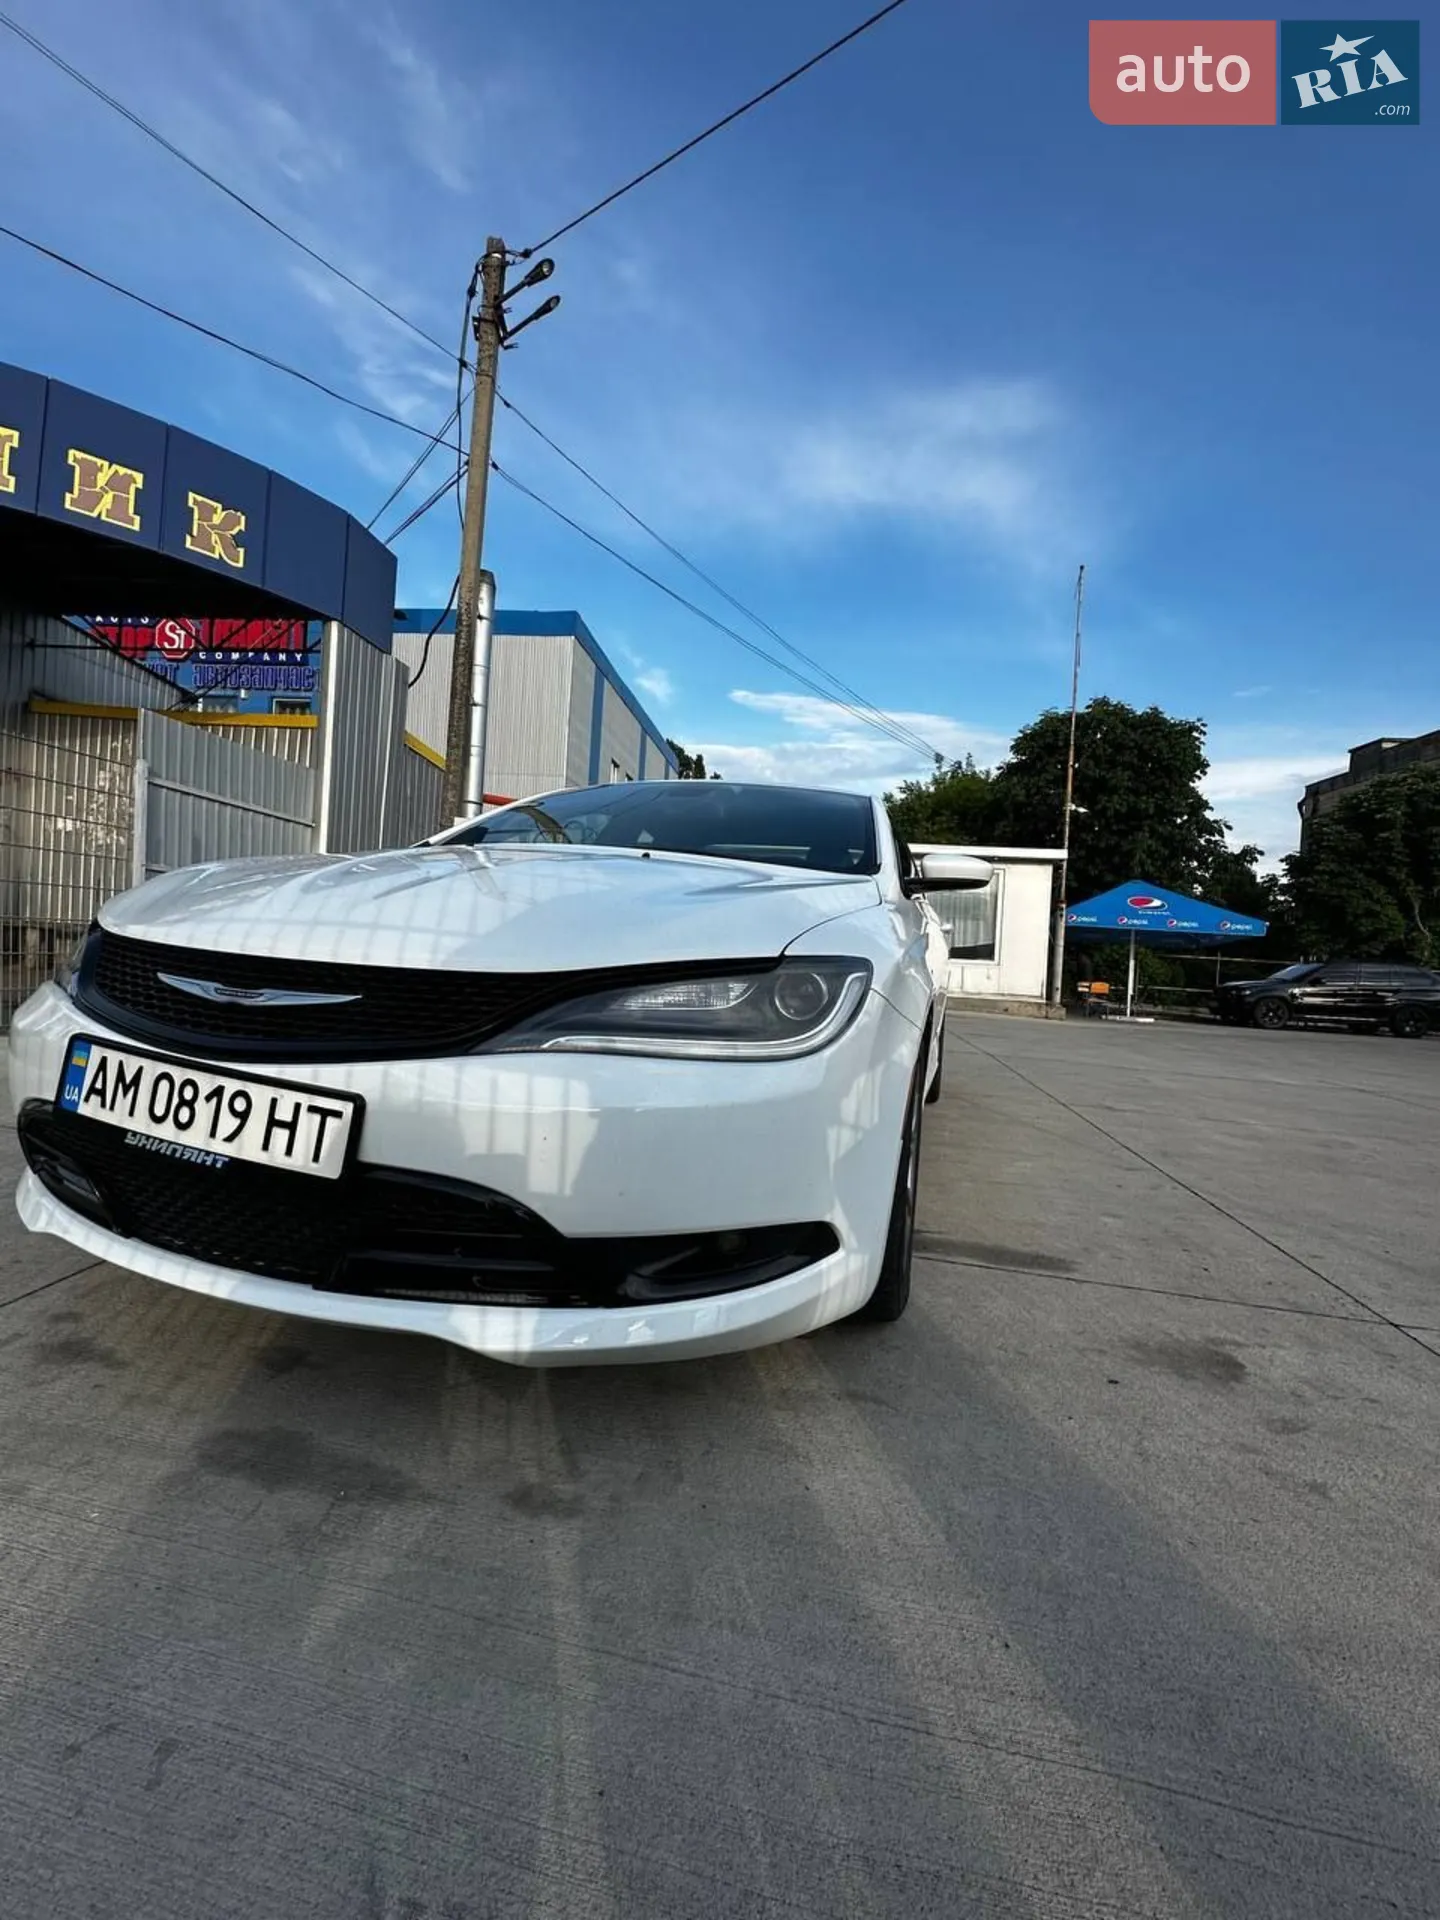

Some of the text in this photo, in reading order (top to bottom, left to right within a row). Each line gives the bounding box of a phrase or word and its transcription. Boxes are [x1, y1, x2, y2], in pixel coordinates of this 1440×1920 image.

[199, 651, 302, 662] COMPANY
[64, 1084, 79, 1103] UA
[84, 1055, 343, 1164] AM 0819 HT
